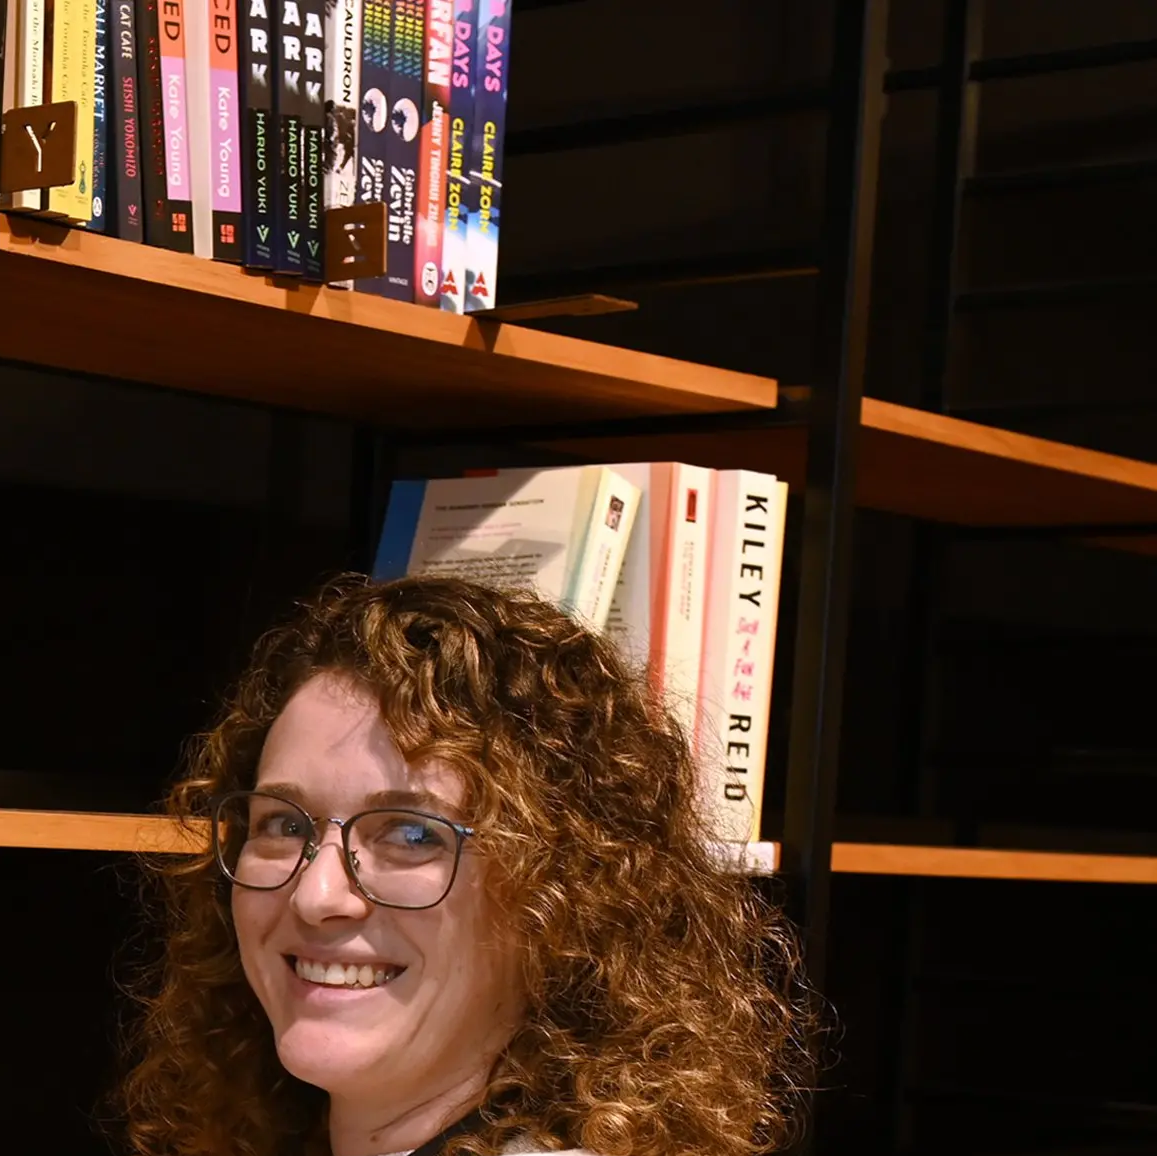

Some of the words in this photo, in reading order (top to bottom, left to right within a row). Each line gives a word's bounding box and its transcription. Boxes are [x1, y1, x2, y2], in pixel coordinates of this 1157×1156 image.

[119, 4, 132, 28] CAT
[93, 45, 107, 122] MARKET
[453, 20, 472, 89] DAYS
[484, 26, 504, 93] DAYS
[122, 76, 134, 113] SEISHI
[168, 74, 183, 120] Kate
[218, 86, 232, 131] Kate
[123, 115, 138, 178] YOKOMIZO
[169, 127, 184, 187] Young
[218, 137, 233, 198] Young
[256, 112, 267, 171] HARUO
[288, 119, 298, 178] HARUO
[309, 130, 319, 188] HARUO
[450, 117, 465, 179] CLAIRE
[481, 121, 496, 183] CLAIRE
[257, 176, 268, 214] YUKI
[288, 182, 298, 220] YUKI
[309, 192, 319, 229] YUKI
[447, 180, 462, 231] ZORN
[479, 185, 494, 233] ZORN
[738, 494, 768, 608] KILEY
[724, 714, 752, 802] REID
